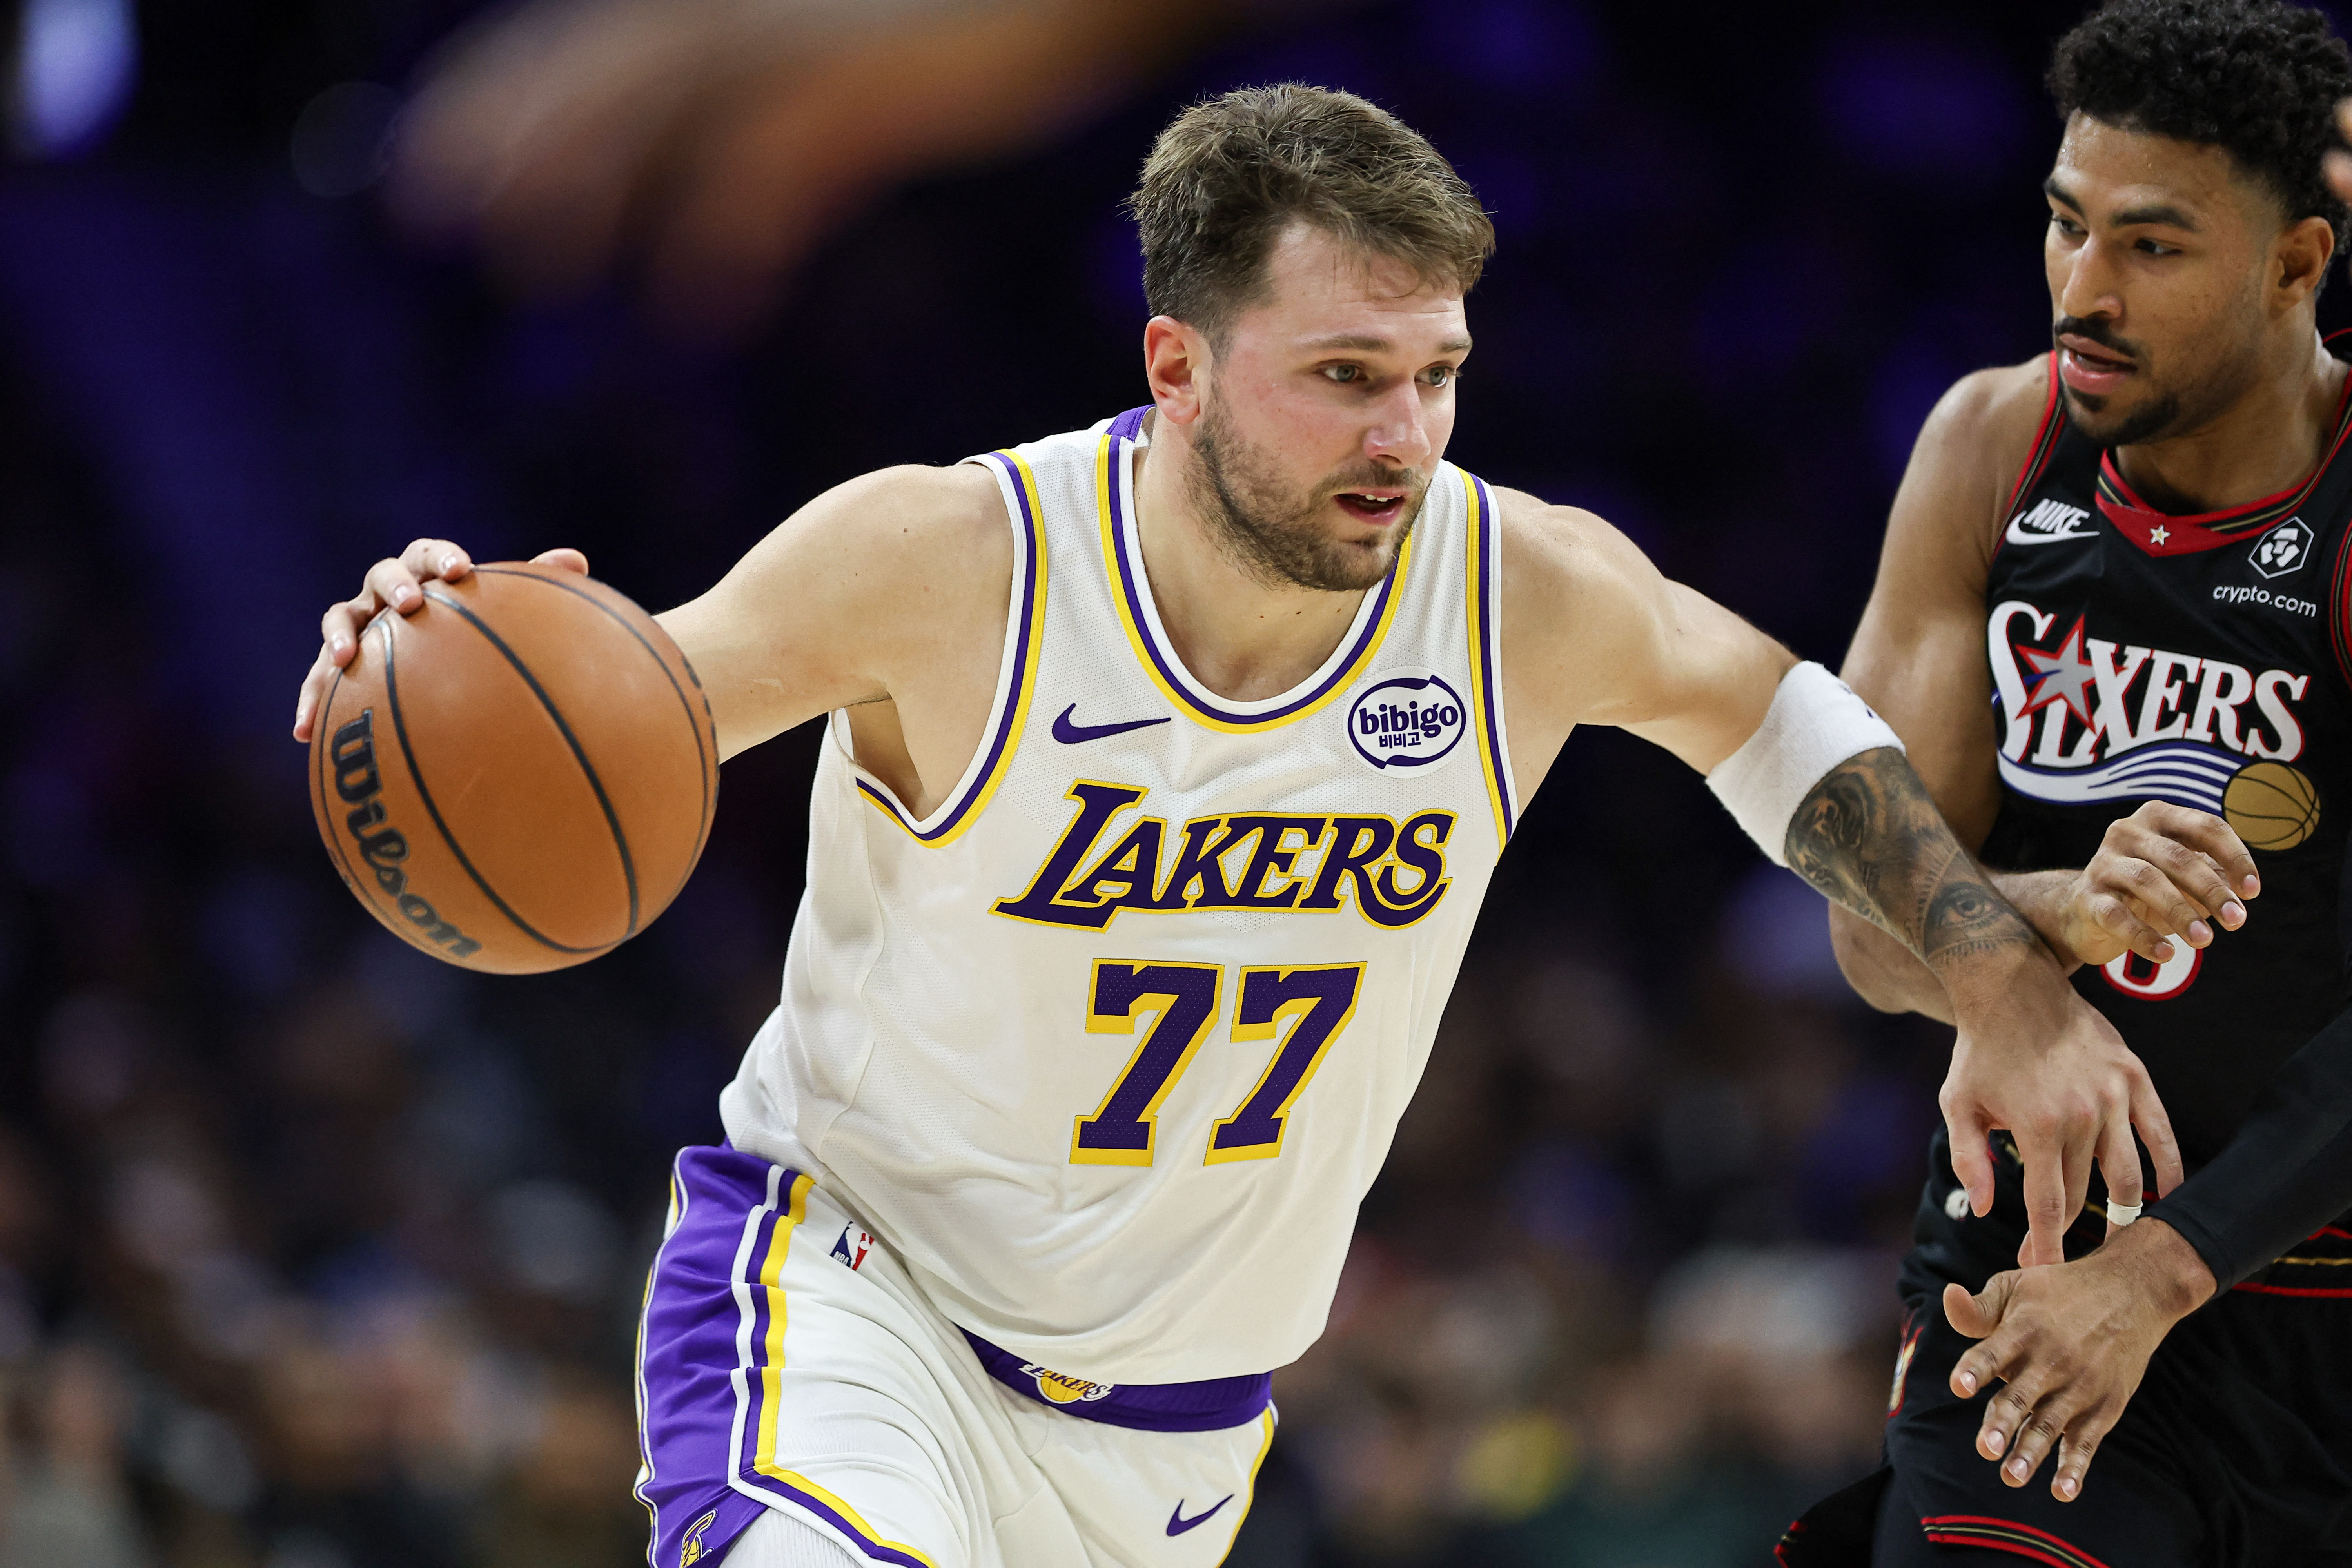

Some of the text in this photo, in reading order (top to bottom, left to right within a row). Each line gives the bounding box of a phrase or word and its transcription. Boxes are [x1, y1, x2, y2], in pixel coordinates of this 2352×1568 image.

[2023, 498, 2091, 535] NIKE
[2212, 585, 2317, 617] crypto.com
[1359, 701, 1458, 738] bibigo
[1379, 732, 1421, 749] 비비고
[331, 708, 483, 958] Wilson
[987, 778, 1459, 933] LAKERS
[1069, 958, 1368, 1166] 77
